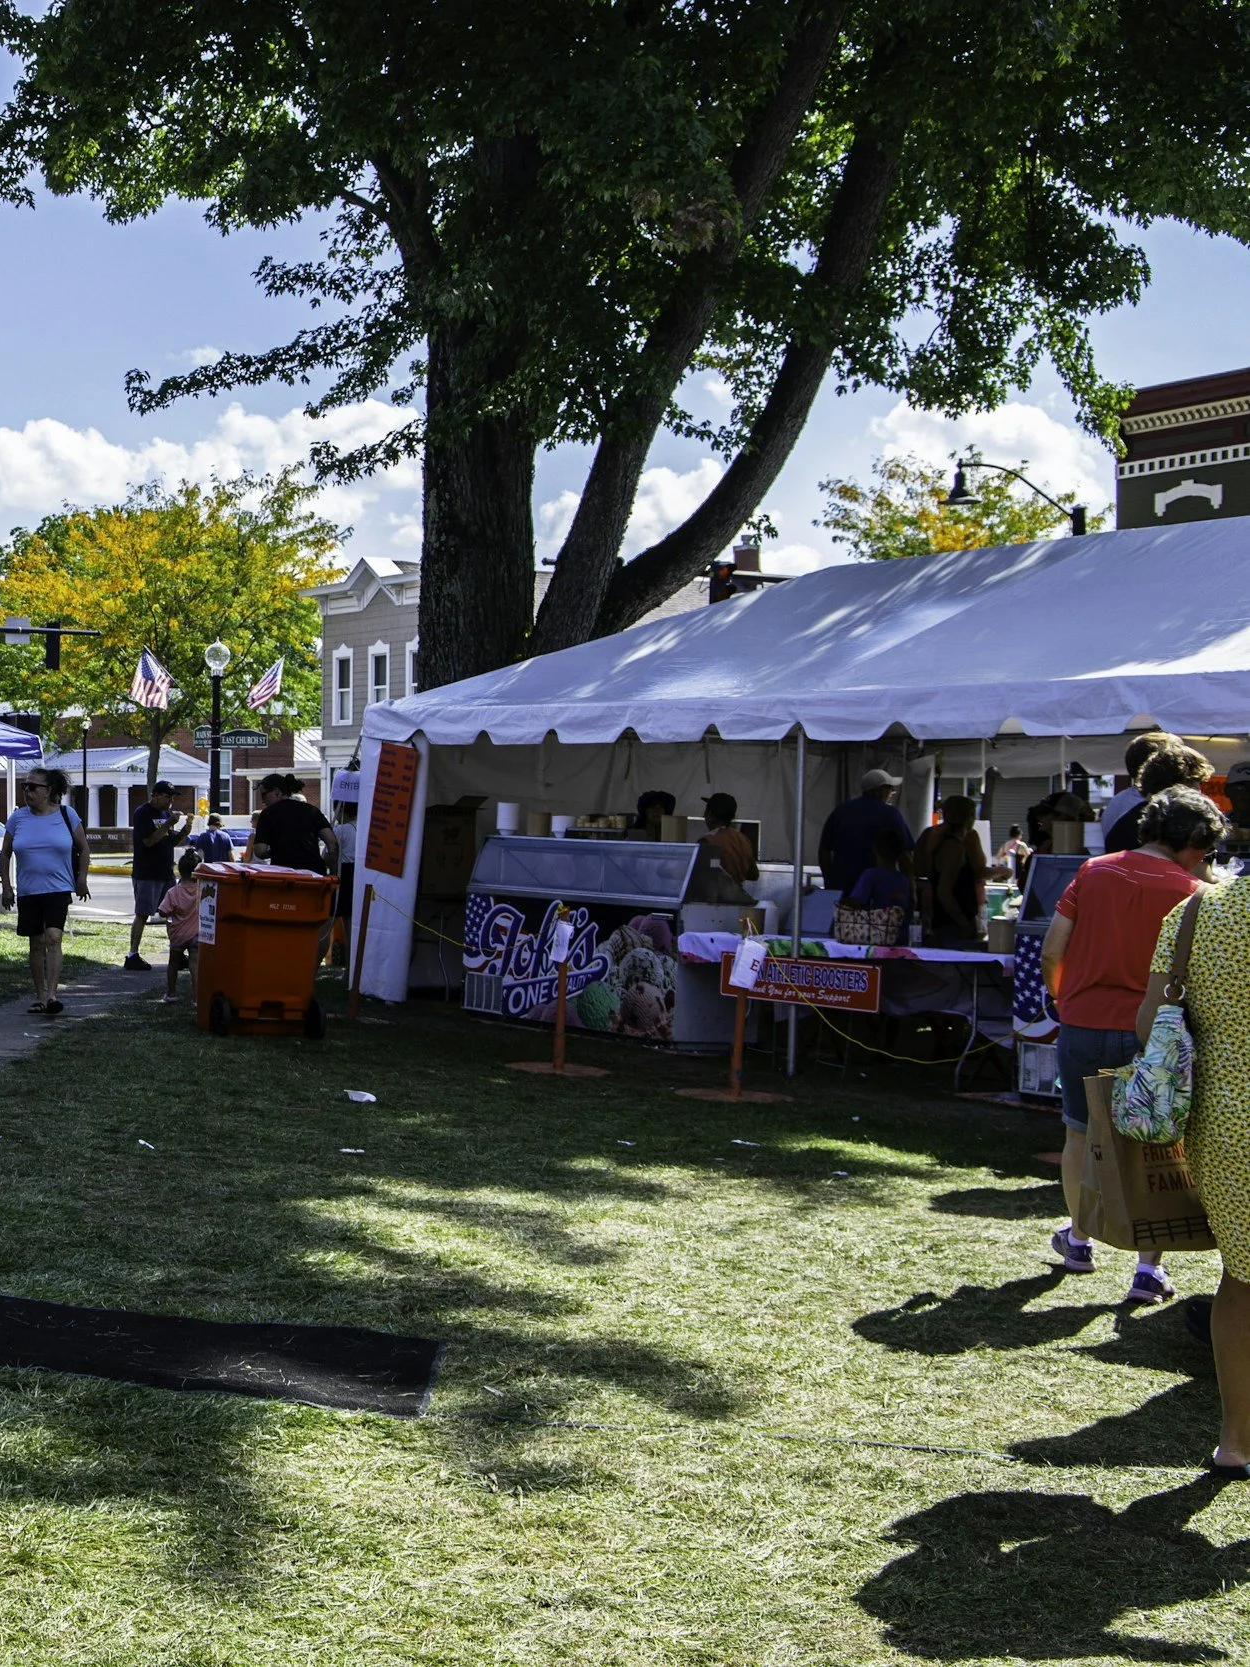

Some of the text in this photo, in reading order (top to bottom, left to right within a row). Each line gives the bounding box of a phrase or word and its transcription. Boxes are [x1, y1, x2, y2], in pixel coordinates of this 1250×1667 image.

[196, 731, 206, 739] MAIN
[221, 736, 235, 744] EAST
[236, 736, 258, 744] CHURCH
[259, 736, 266, 744] ST
[340, 781, 360, 790] ENTE
[768, 962, 813, 986] ATHLETIC
[814, 966, 869, 992] BOOSTERS
[508, 975, 588, 1014] ONE QALITY
[768, 984, 783, 997] You
[784, 986, 796, 998] for
[817, 989, 851, 1003] Support
